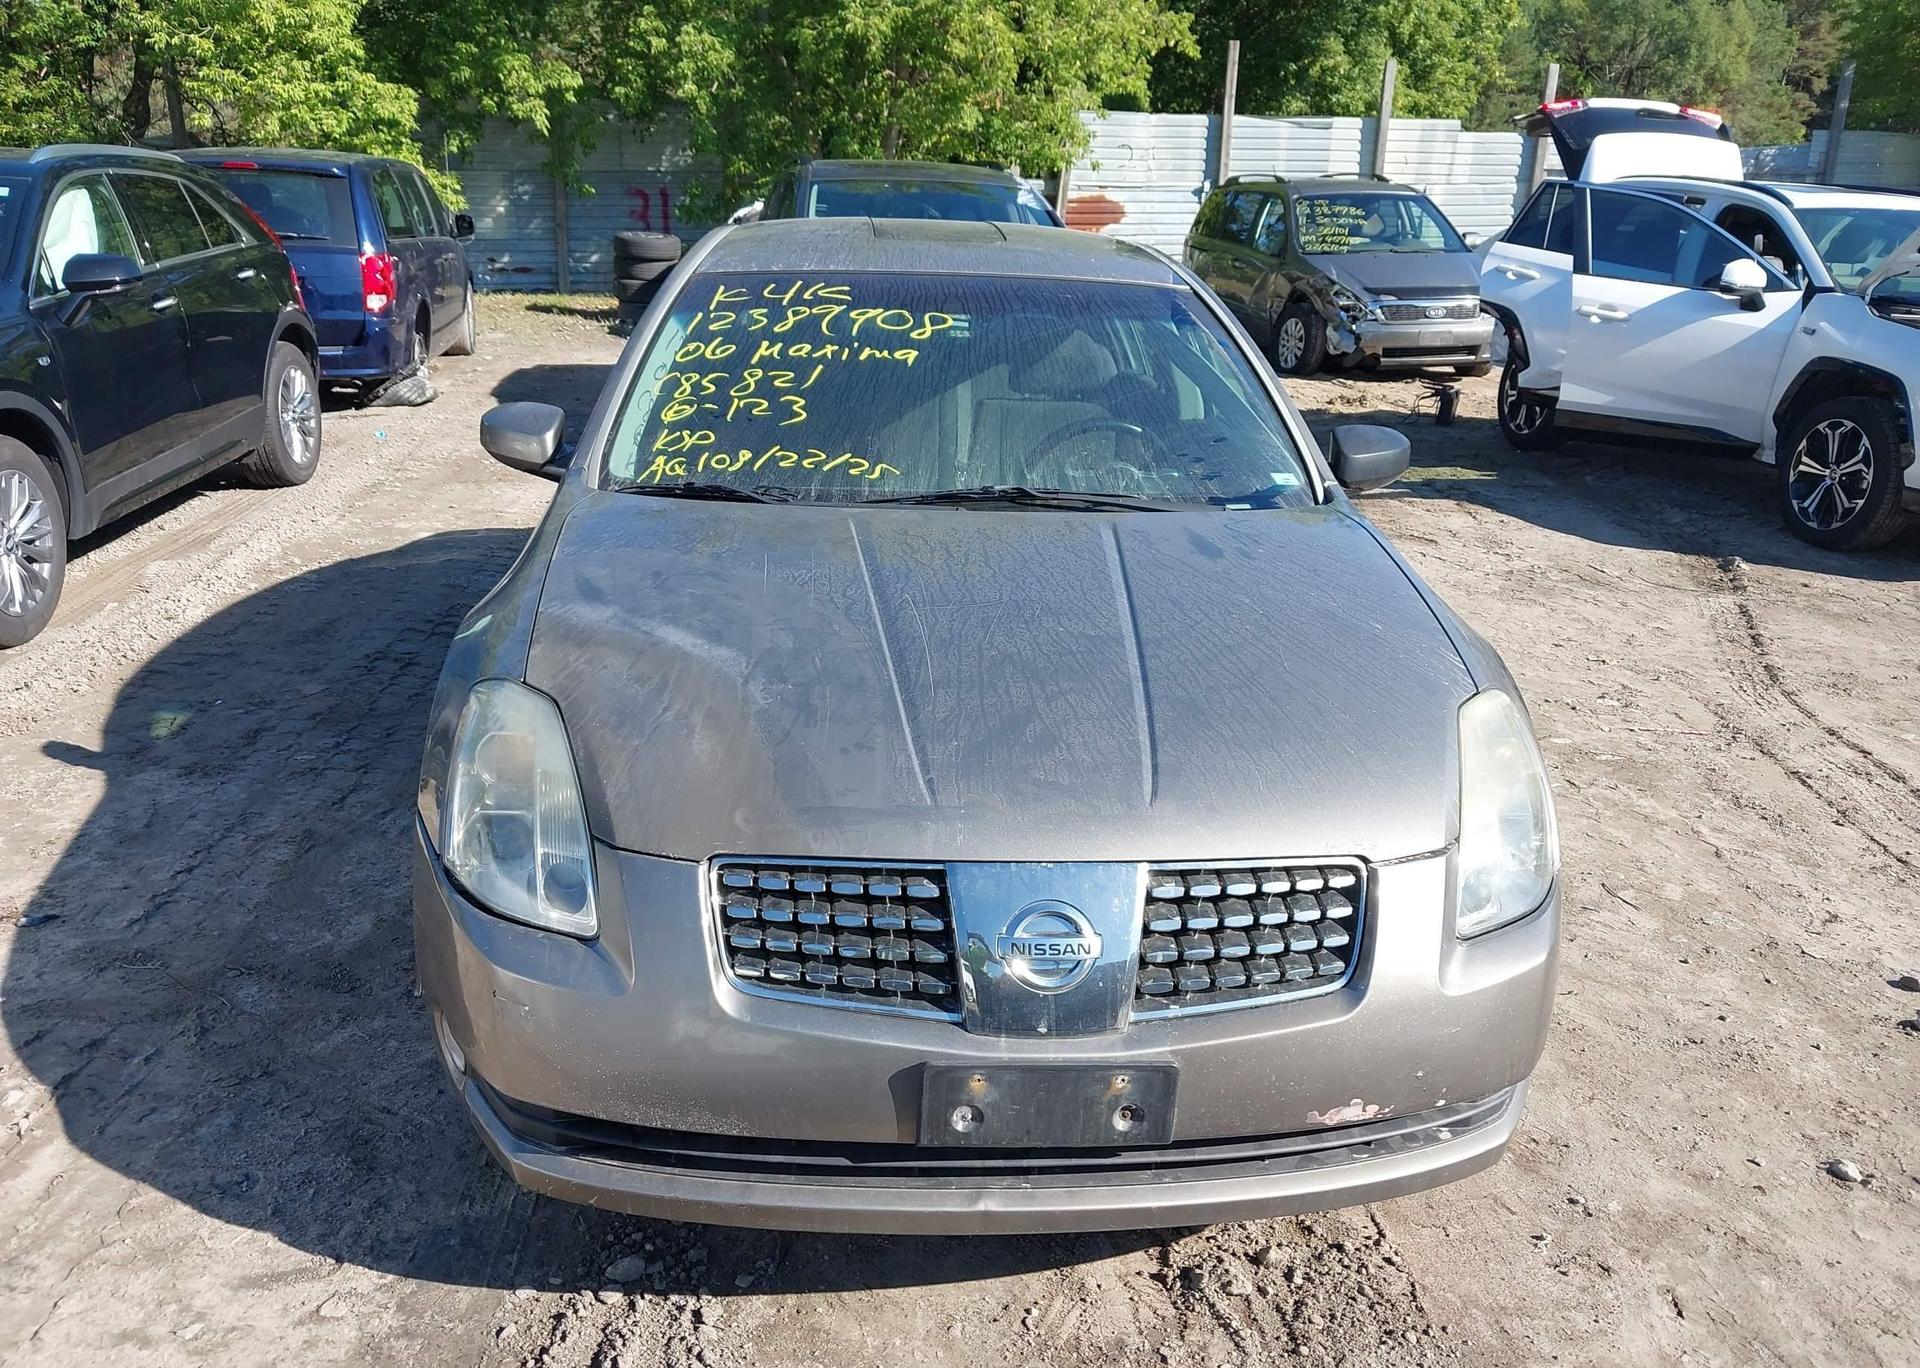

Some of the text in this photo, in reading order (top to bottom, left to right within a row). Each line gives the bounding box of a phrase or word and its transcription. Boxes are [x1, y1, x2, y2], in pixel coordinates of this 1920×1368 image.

[686, 303, 955, 340] 12389908
[674, 336, 919, 367] 06 Maxima
[1010, 942, 1091, 957] NISSAN
